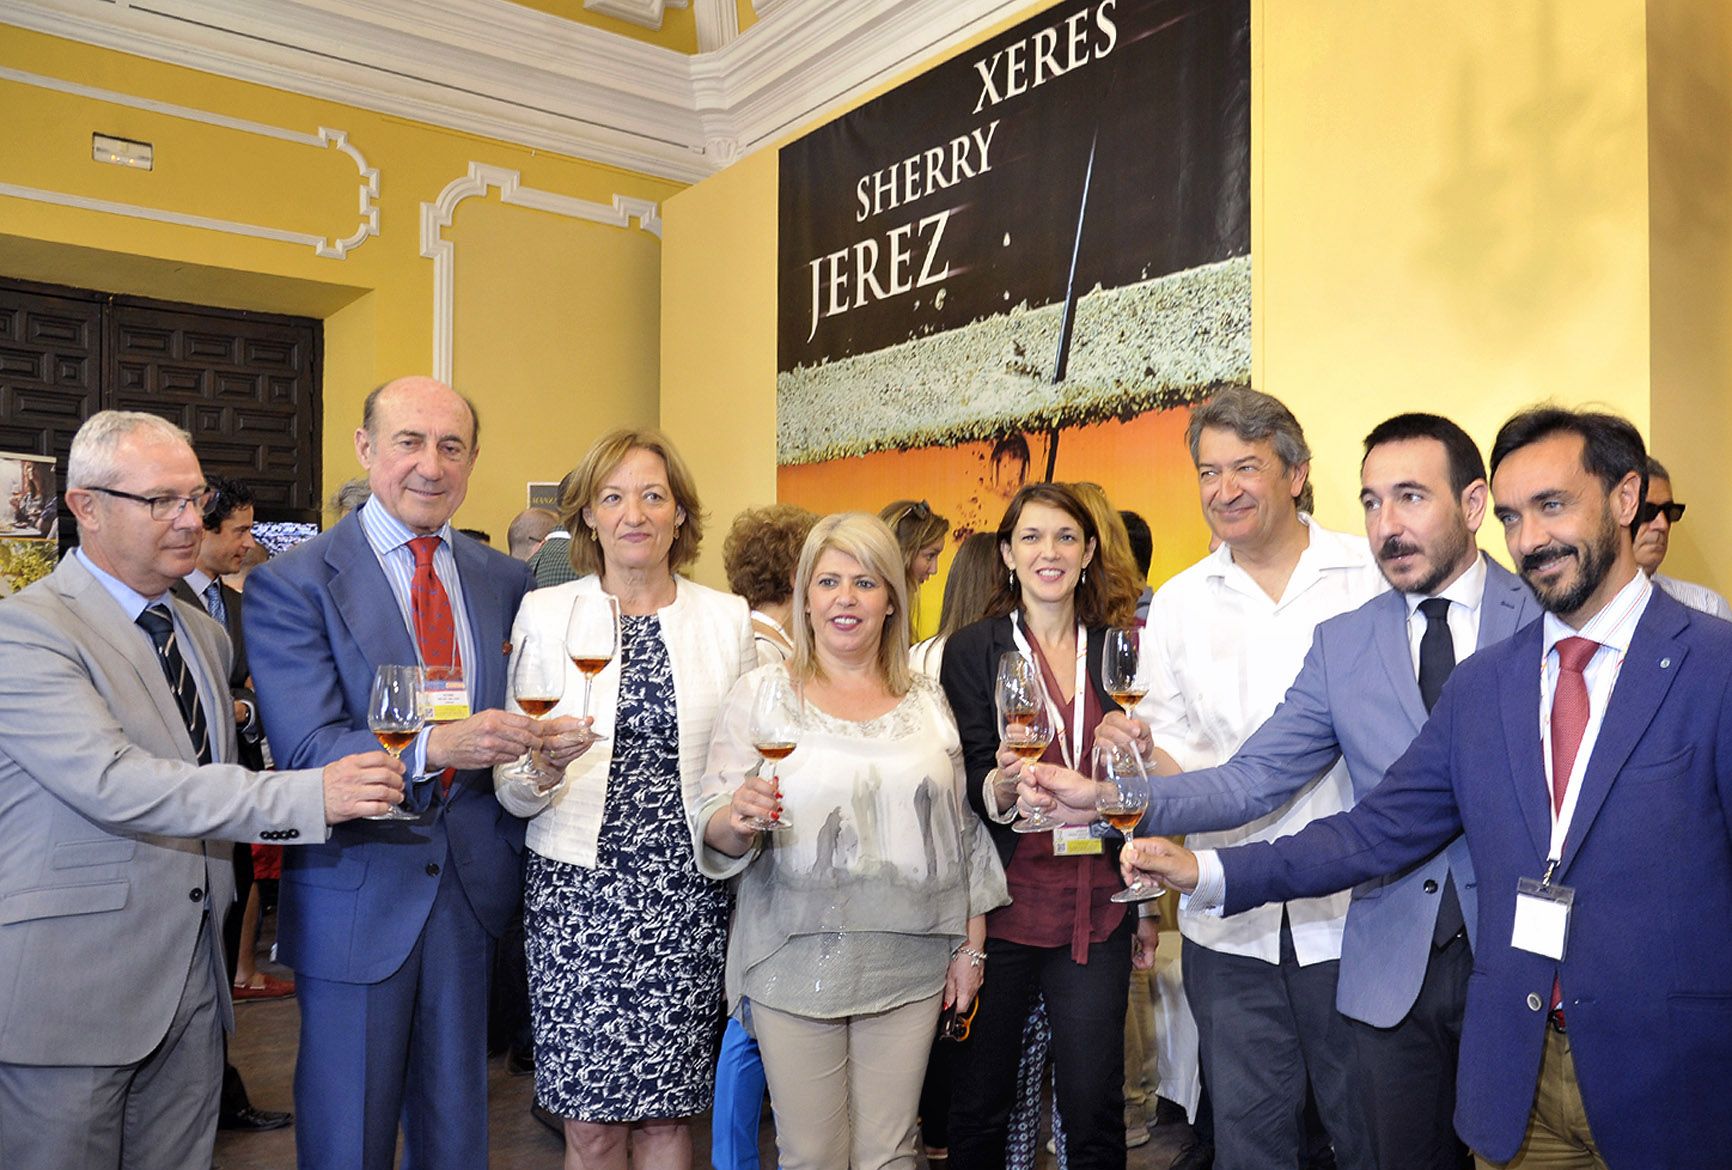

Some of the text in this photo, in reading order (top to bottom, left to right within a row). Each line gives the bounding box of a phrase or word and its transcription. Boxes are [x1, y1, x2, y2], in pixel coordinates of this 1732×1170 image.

[972, 0, 1117, 114] XERES
[856, 120, 999, 222] SHERRY
[807, 209, 950, 343] JEREZ
